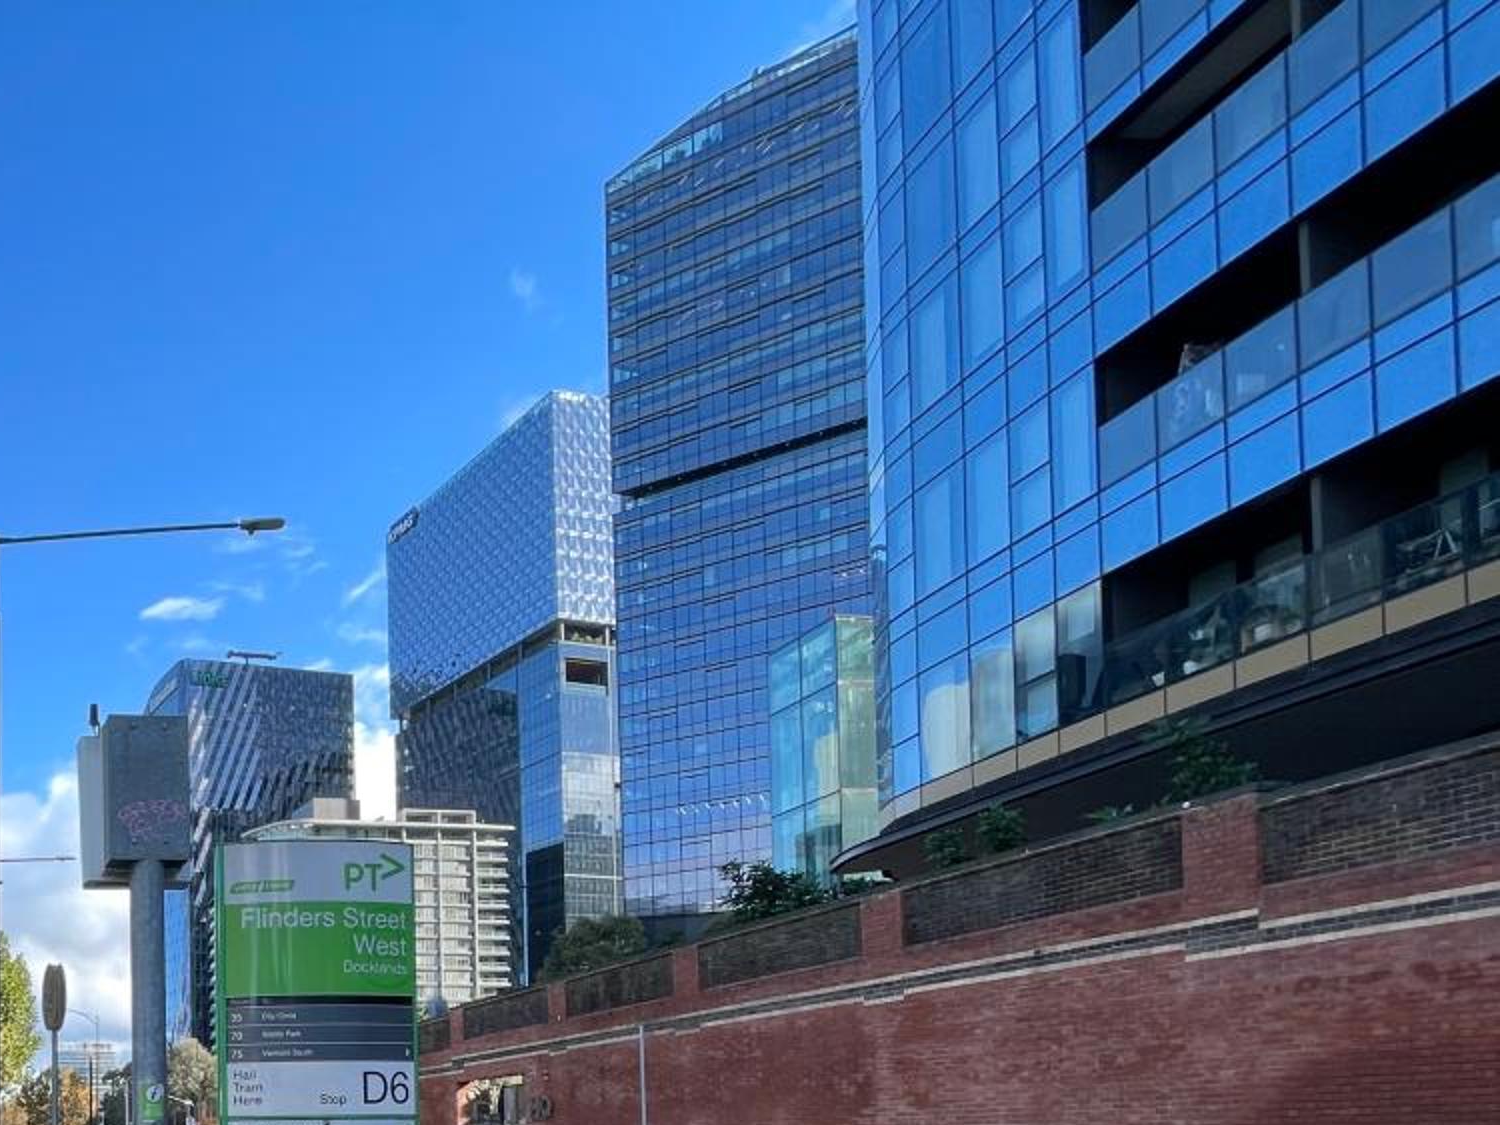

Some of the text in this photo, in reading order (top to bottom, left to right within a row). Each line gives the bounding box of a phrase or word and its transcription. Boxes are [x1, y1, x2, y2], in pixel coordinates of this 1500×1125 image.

[241, 907, 406, 929] Flinders Street
[353, 934, 407, 956] West
[343, 960, 408, 975] Docklands
[231, 1031, 243, 1041] 70
[233, 1070, 257, 1080] Hail
[233, 1082, 263, 1092] Tram
[319, 1071, 410, 1107] Stop D6
[233, 1095, 263, 1105] Here
